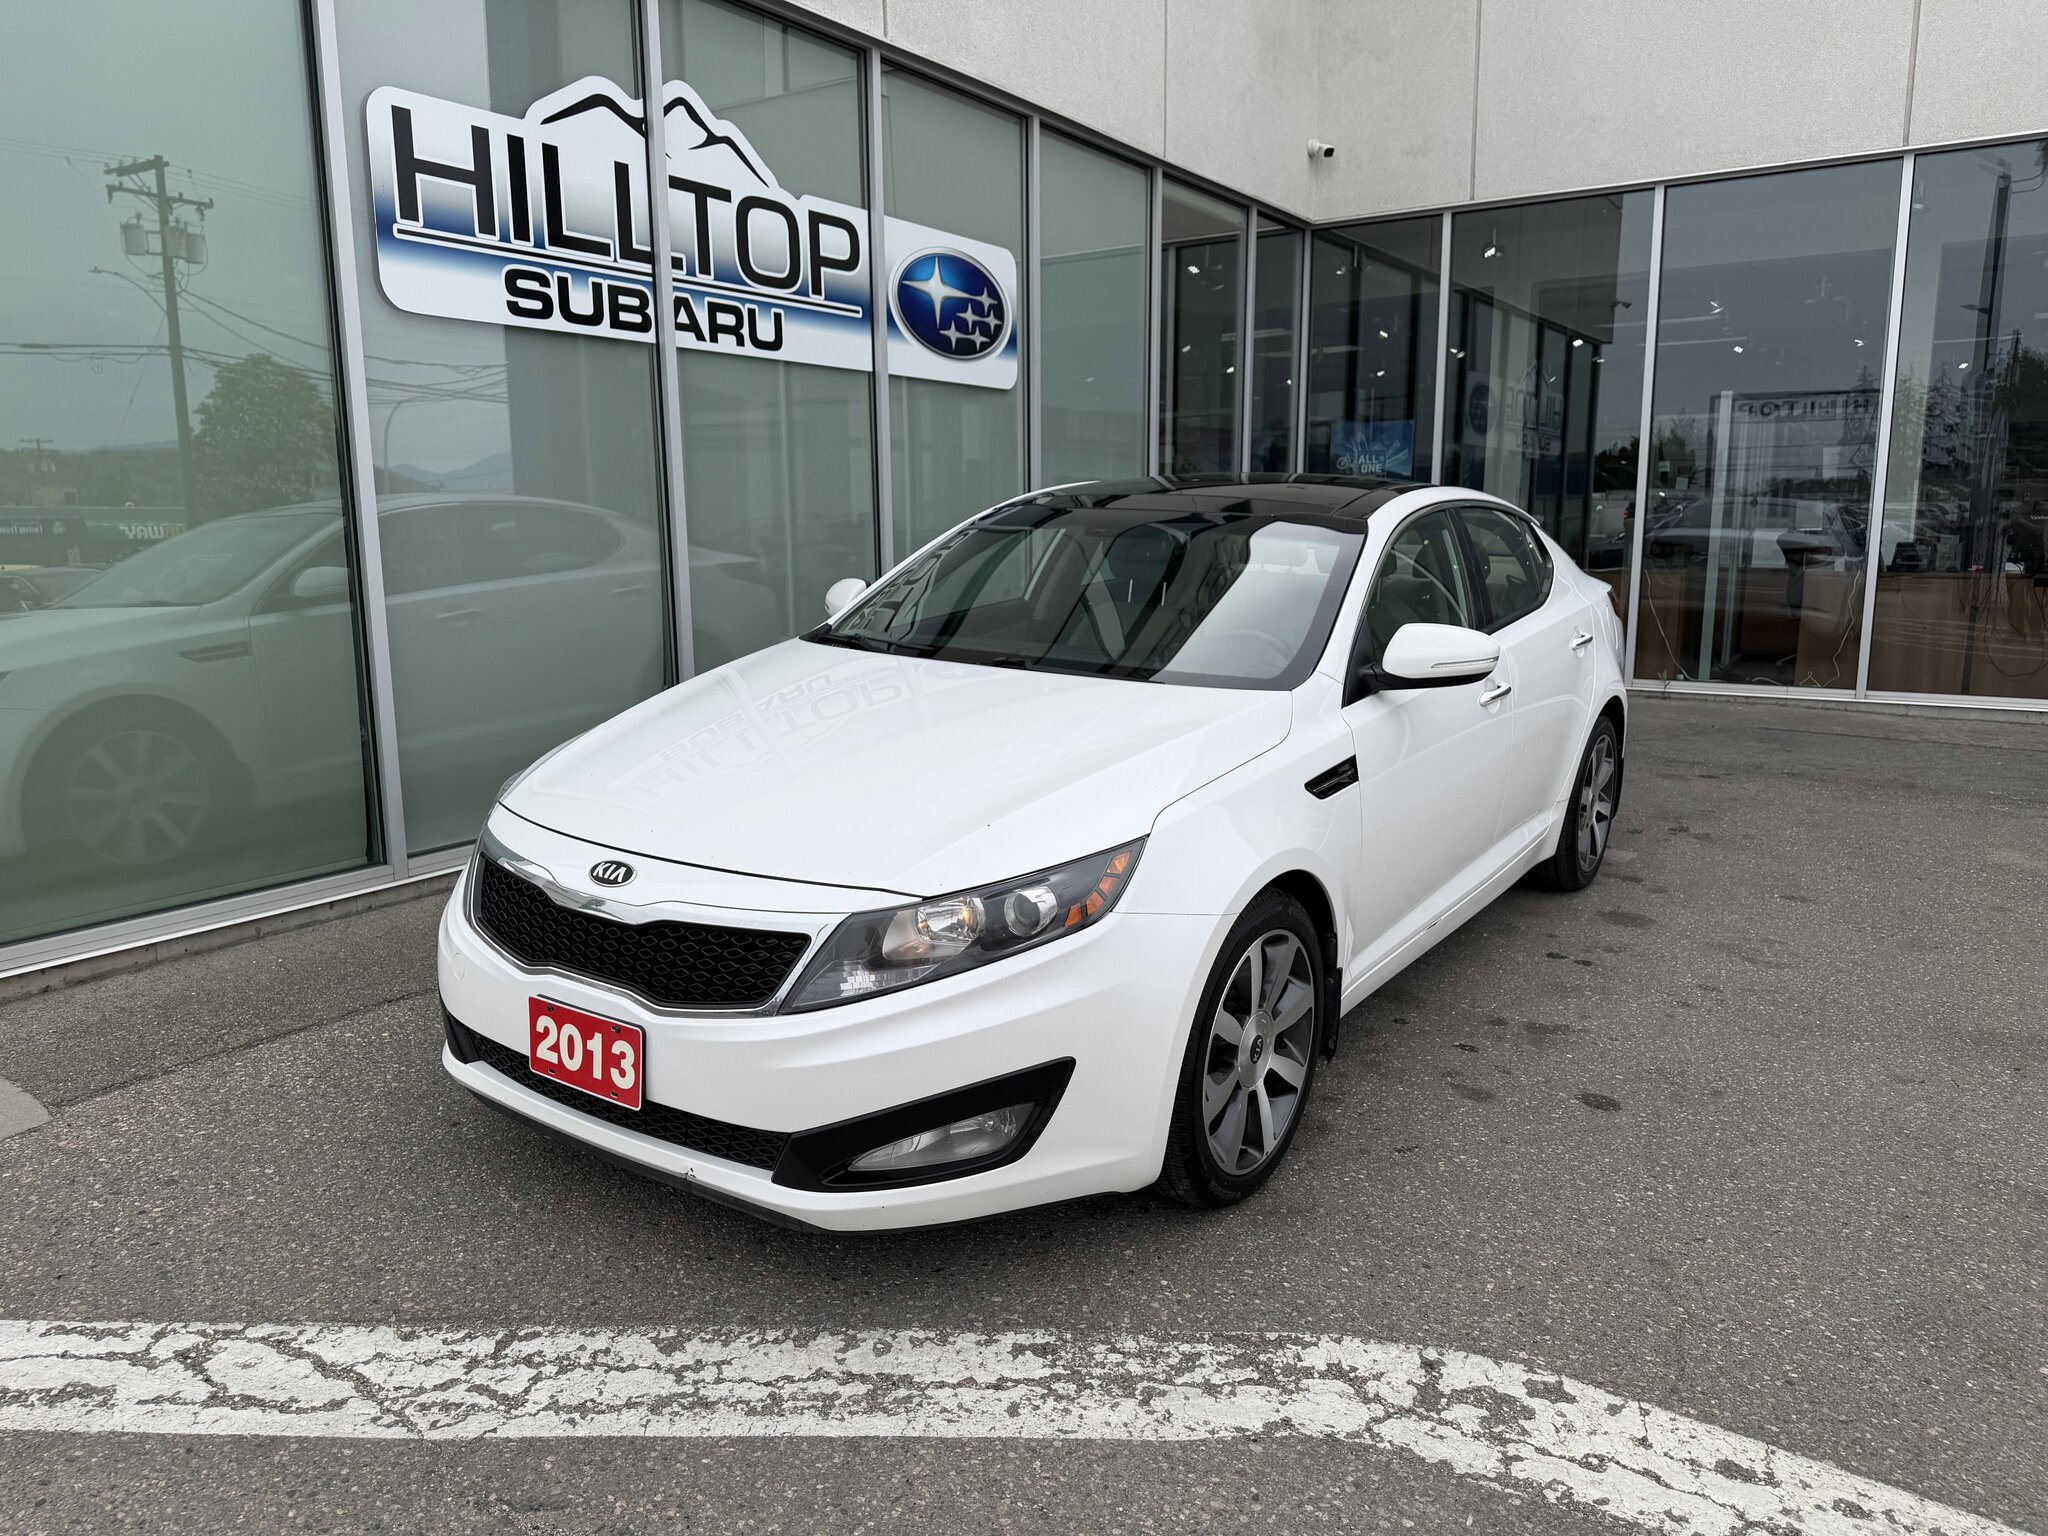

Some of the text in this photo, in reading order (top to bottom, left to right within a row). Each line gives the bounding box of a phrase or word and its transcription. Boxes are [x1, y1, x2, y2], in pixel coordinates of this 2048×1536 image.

[390, 104, 862, 298] HILLTOP
[504, 266, 785, 352] SUBARU
[1359, 455, 1379, 464] ALL
[1361, 463, 1382, 473] ONE
[593, 861, 627, 884] KIA
[535, 1014, 637, 1091] 2013
[1252, 1038, 1263, 1062] KIA
